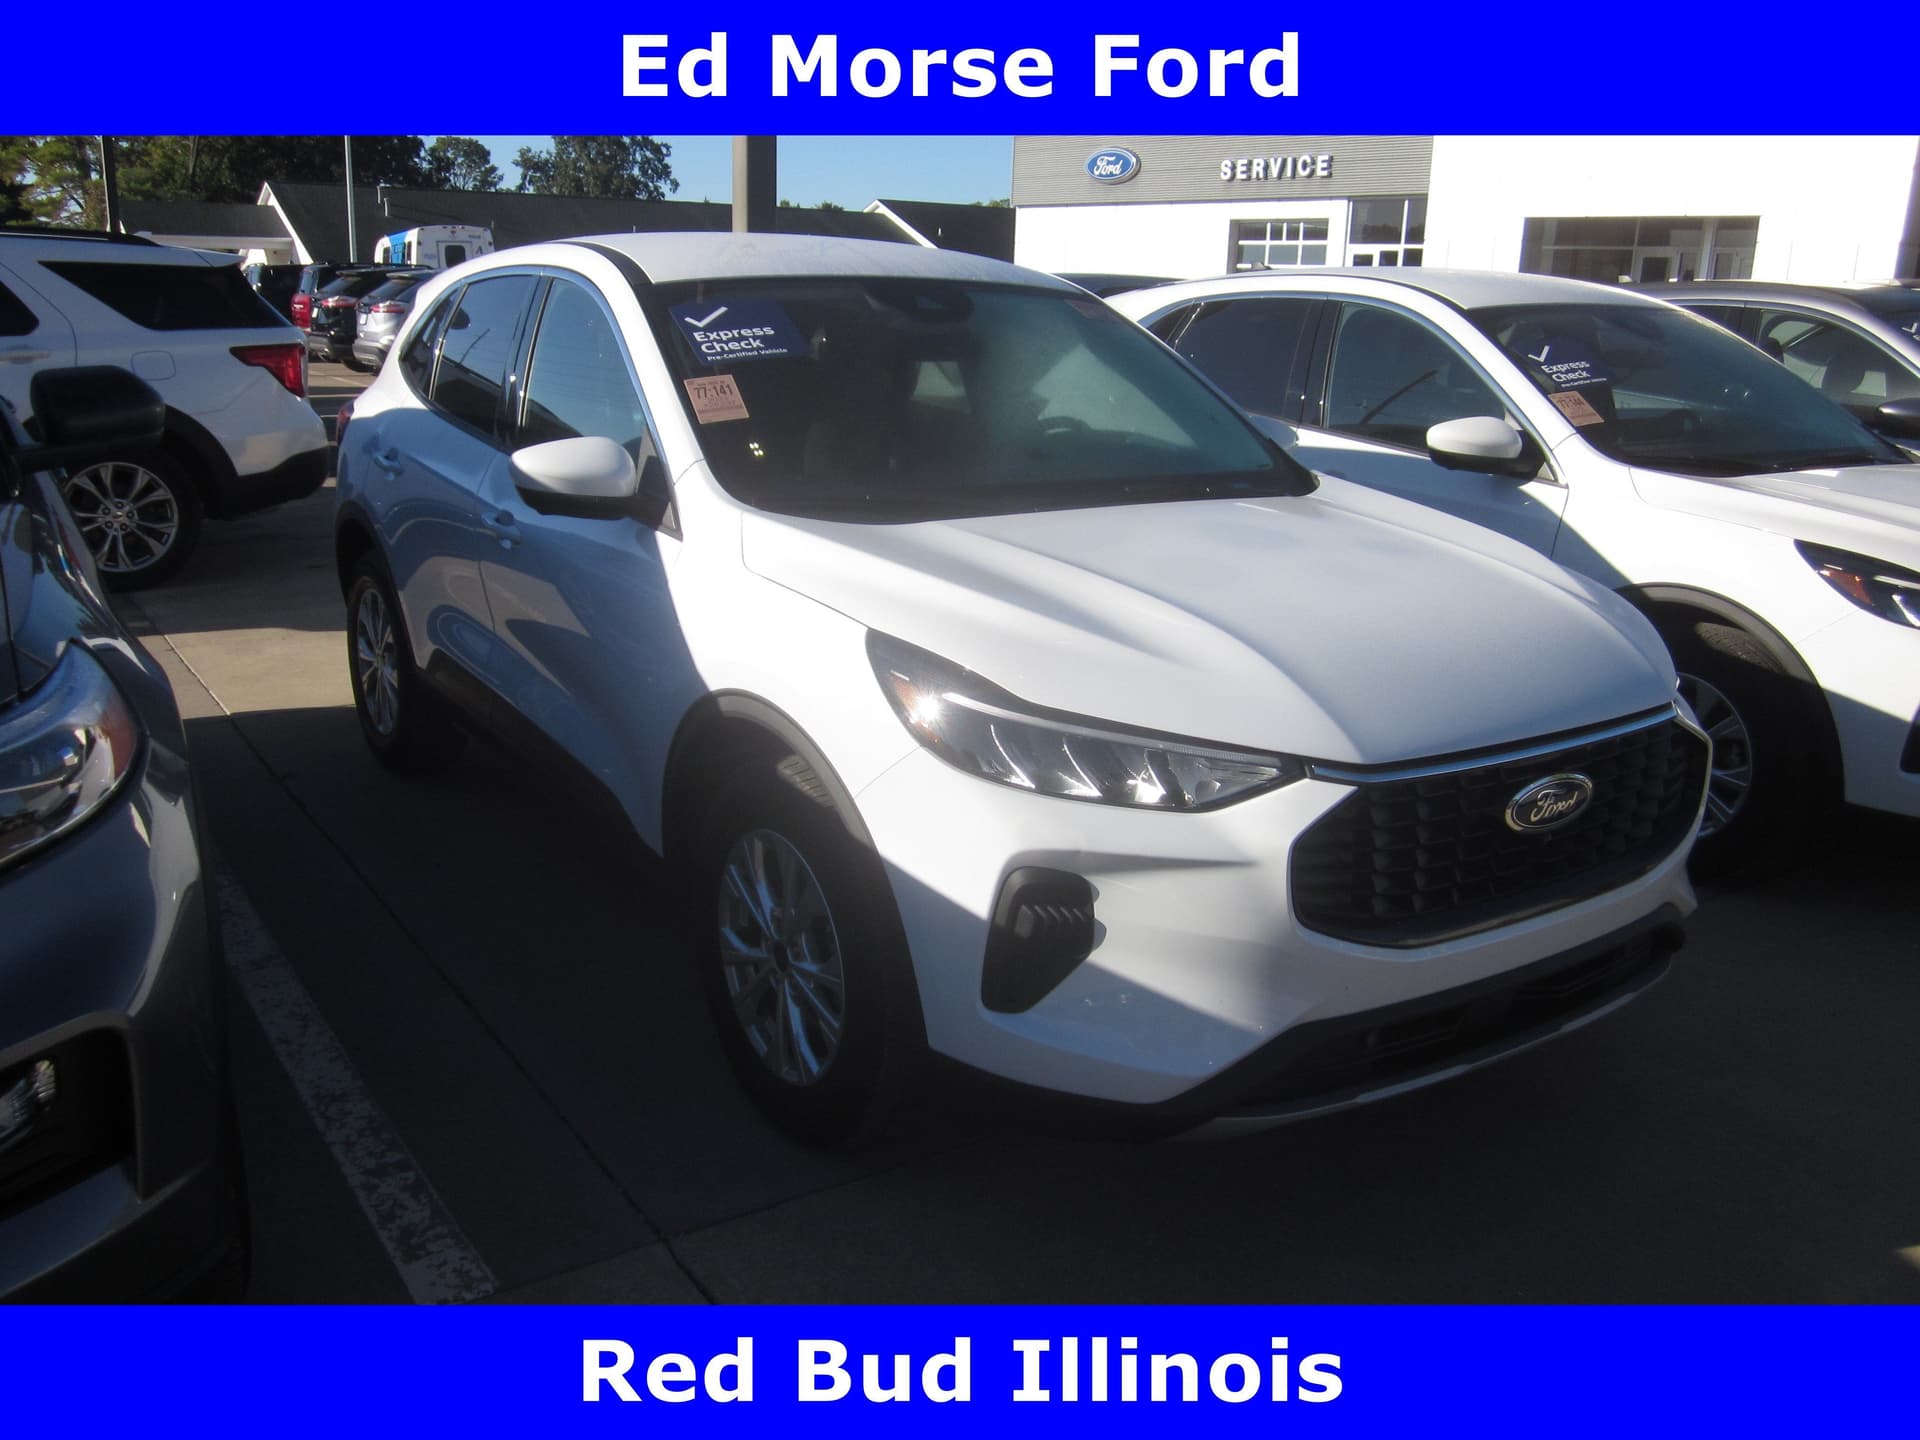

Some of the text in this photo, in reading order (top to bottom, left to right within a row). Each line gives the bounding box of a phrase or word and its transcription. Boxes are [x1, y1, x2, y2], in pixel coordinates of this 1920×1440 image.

[1093, 155, 1124, 176] Ford
[1219, 154, 1332, 181] SERVICE
[692, 326, 776, 342] Express
[700, 337, 765, 354] Check
[1541, 361, 1591, 374] Express
[1552, 370, 1592, 382] Check
[1530, 788, 1579, 823] Ford
